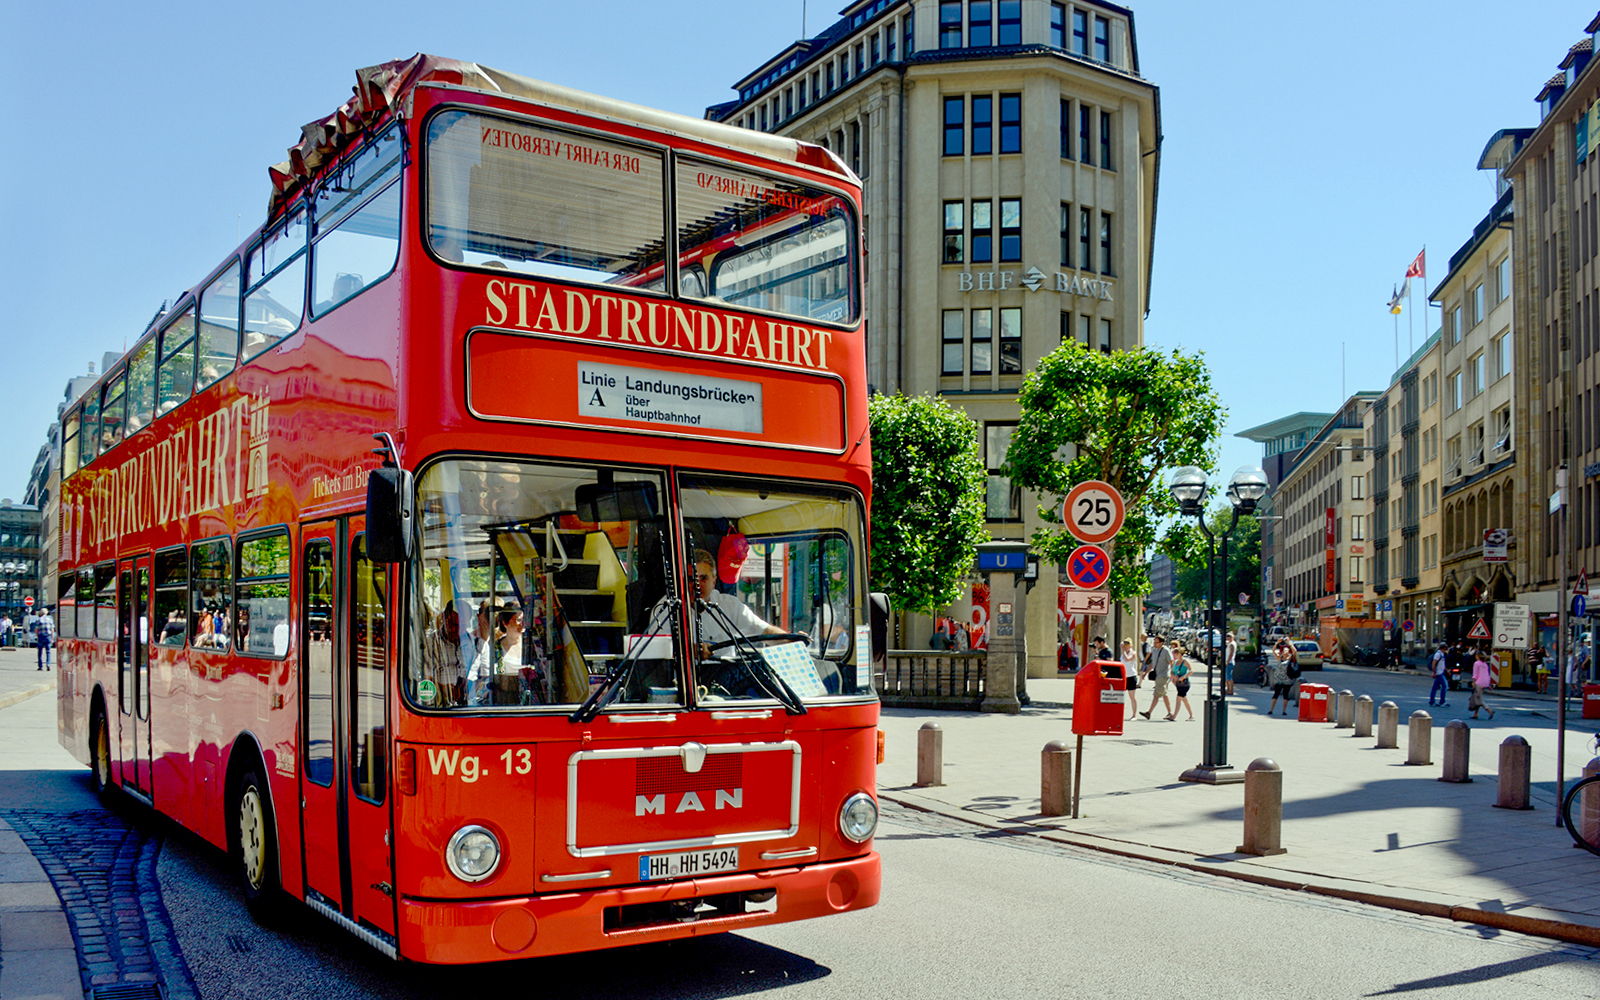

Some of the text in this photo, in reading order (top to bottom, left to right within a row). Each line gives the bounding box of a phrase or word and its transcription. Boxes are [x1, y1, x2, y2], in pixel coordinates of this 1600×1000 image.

[958, 271, 1114, 301] BHF BANK
[485, 279, 832, 370] STADTRUNDFAHRT
[582, 370, 616, 388] Linie
[588, 387, 650, 407] A über
[625, 407, 701, 425] Hauptbahnhof
[89, 394, 249, 547] STADTRUNDFAHRT
[313, 465, 372, 499] Tickets im Bu
[1077, 498, 1111, 526] 25
[996, 554, 1008, 567] U
[428, 749, 532, 783] Wg. 13
[635, 788, 743, 817] MAN
[650, 857, 669, 876] HH
[680, 854, 699, 873] HH
[702, 850, 737, 870] 5494
